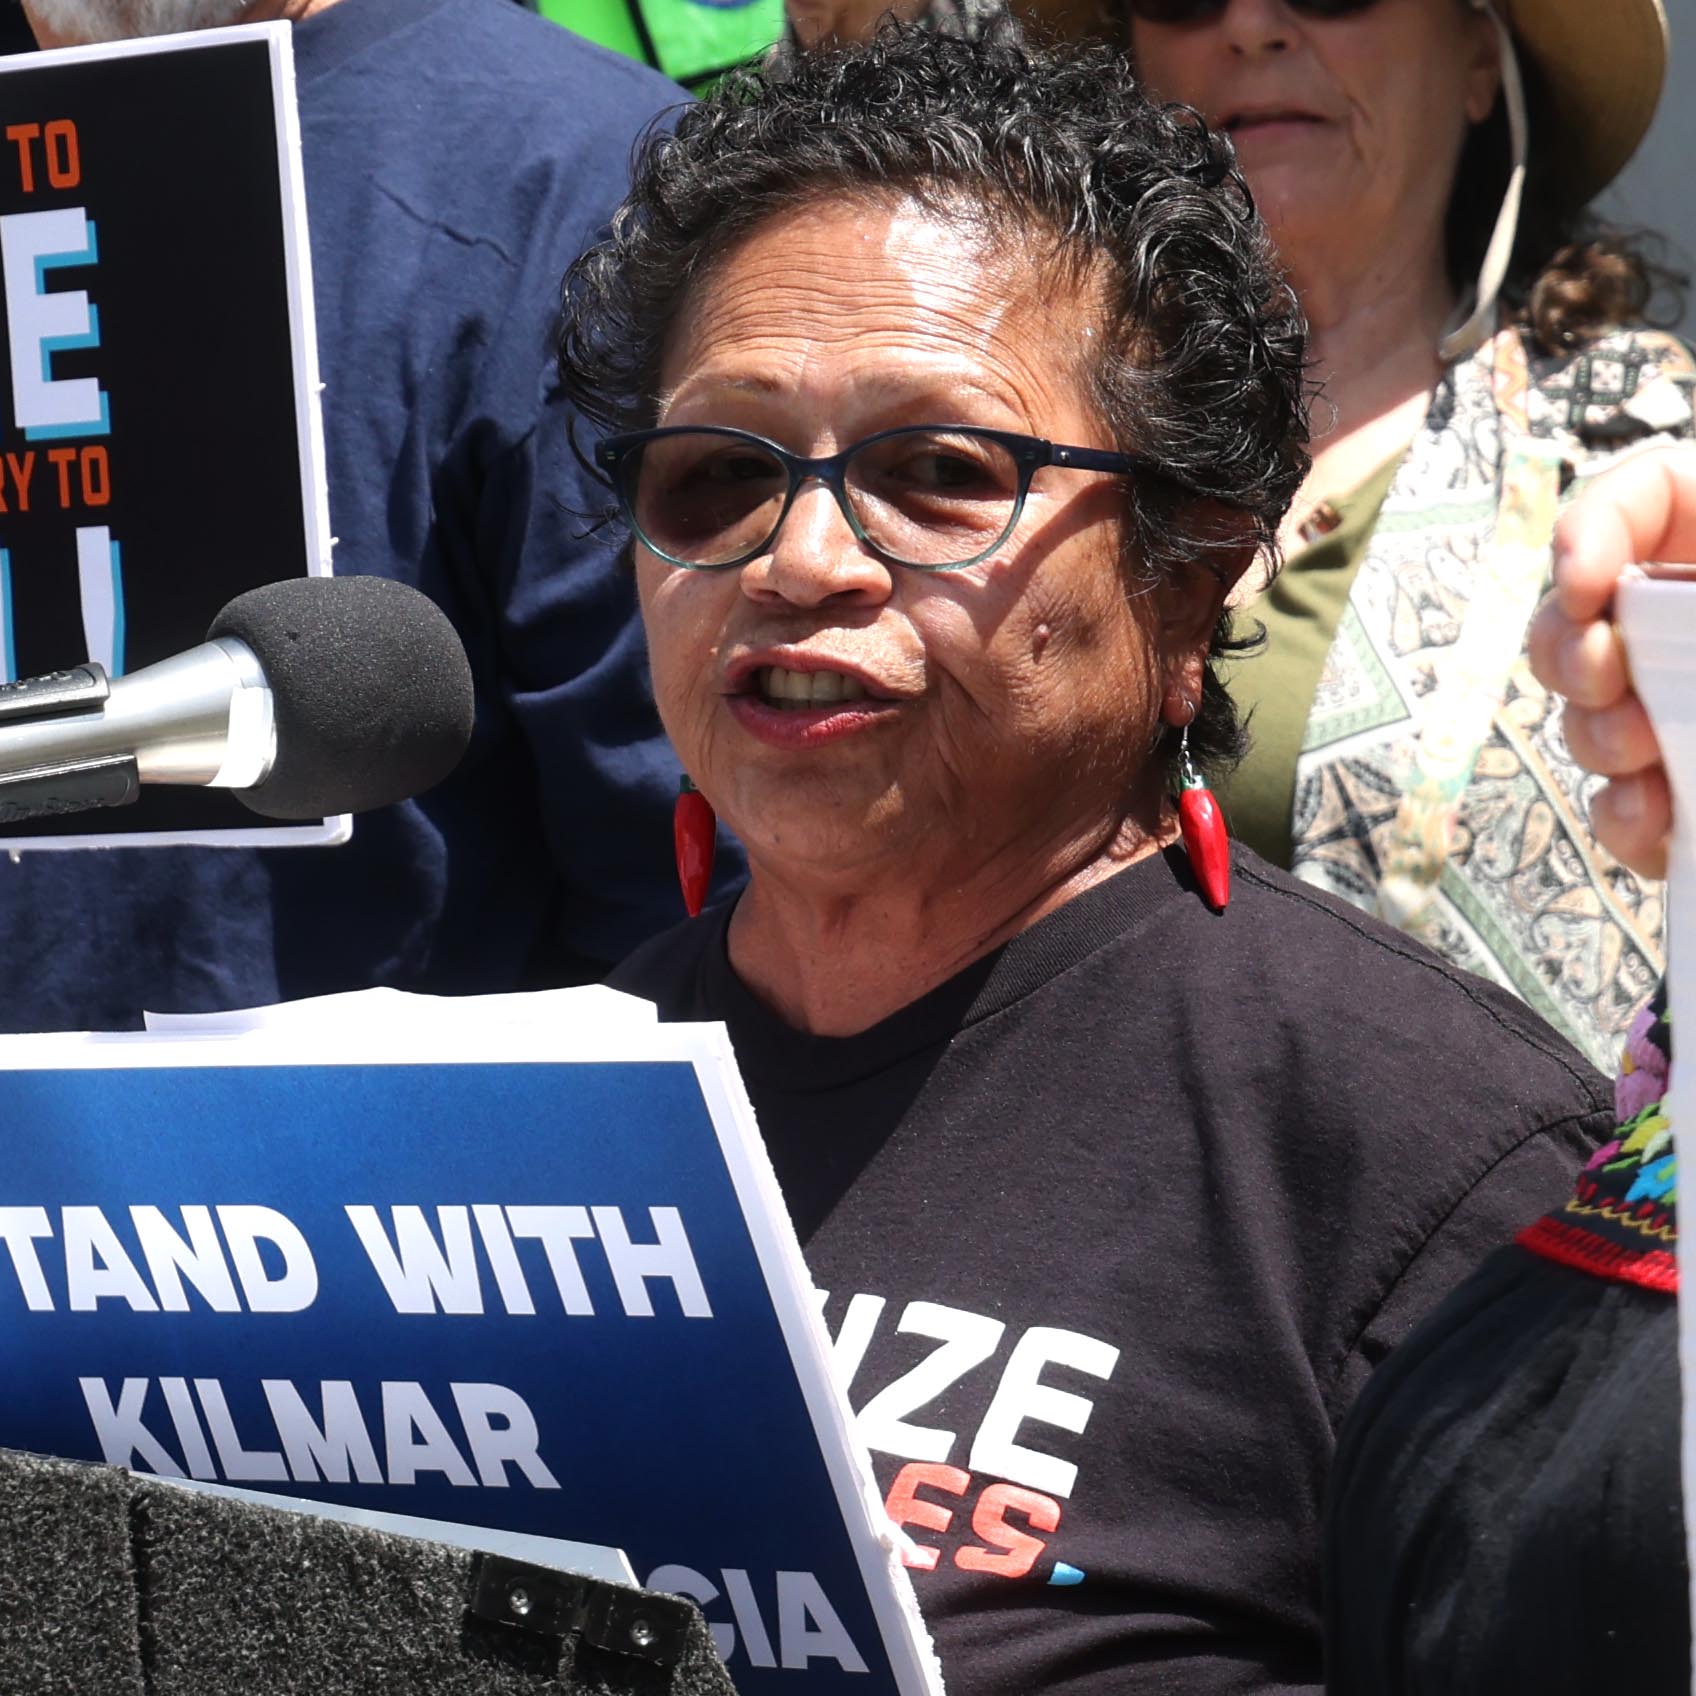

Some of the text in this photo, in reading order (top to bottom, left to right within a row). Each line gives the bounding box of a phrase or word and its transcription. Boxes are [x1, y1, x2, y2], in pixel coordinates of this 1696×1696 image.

[5, 118, 82, 193] TO
[46, 445, 113, 508] TO
[343, 1202, 715, 1319] WITH
[76, 1374, 563, 1492] KILMAR
